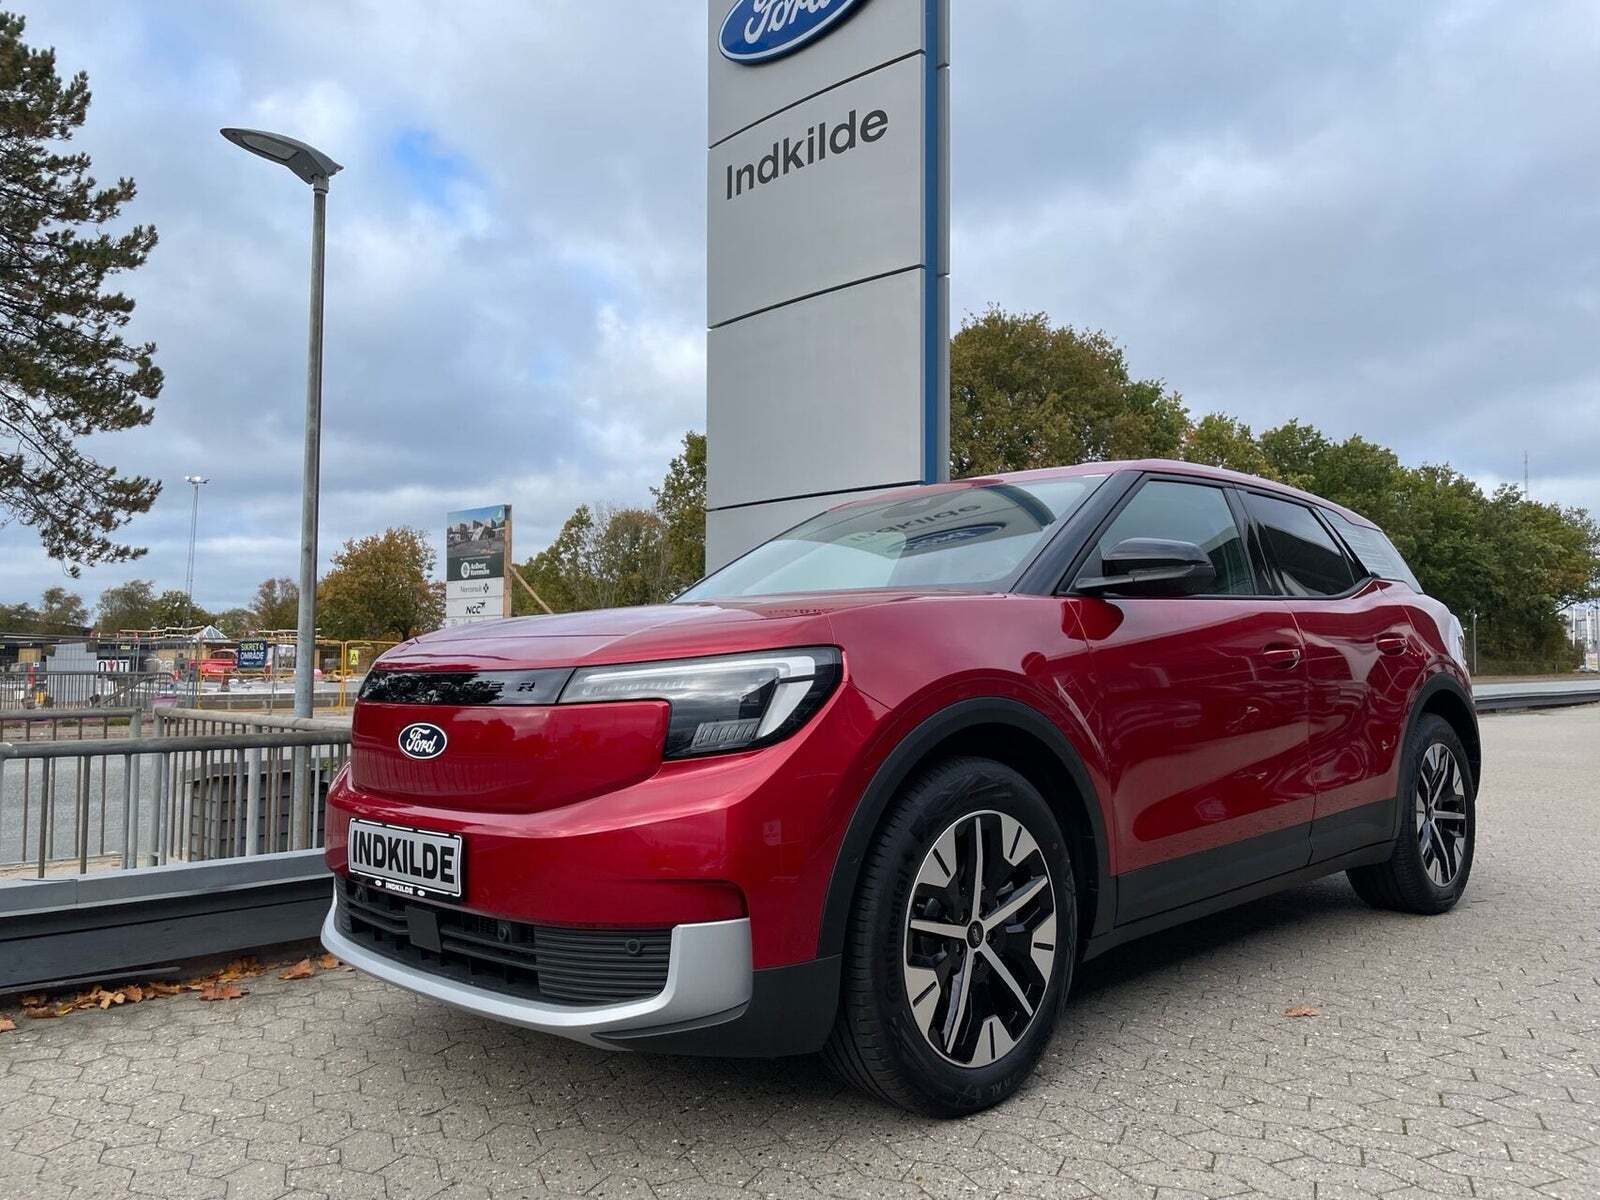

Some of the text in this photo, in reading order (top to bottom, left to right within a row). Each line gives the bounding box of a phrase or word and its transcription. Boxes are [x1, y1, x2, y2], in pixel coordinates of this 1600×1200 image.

[727, 109, 889, 200] Indkilde
[466, 605, 481, 615] NCC
[406, 727, 437, 753] Ford
[353, 829, 455, 884] INDKILDE
[385, 881, 414, 895] INDKILDE
